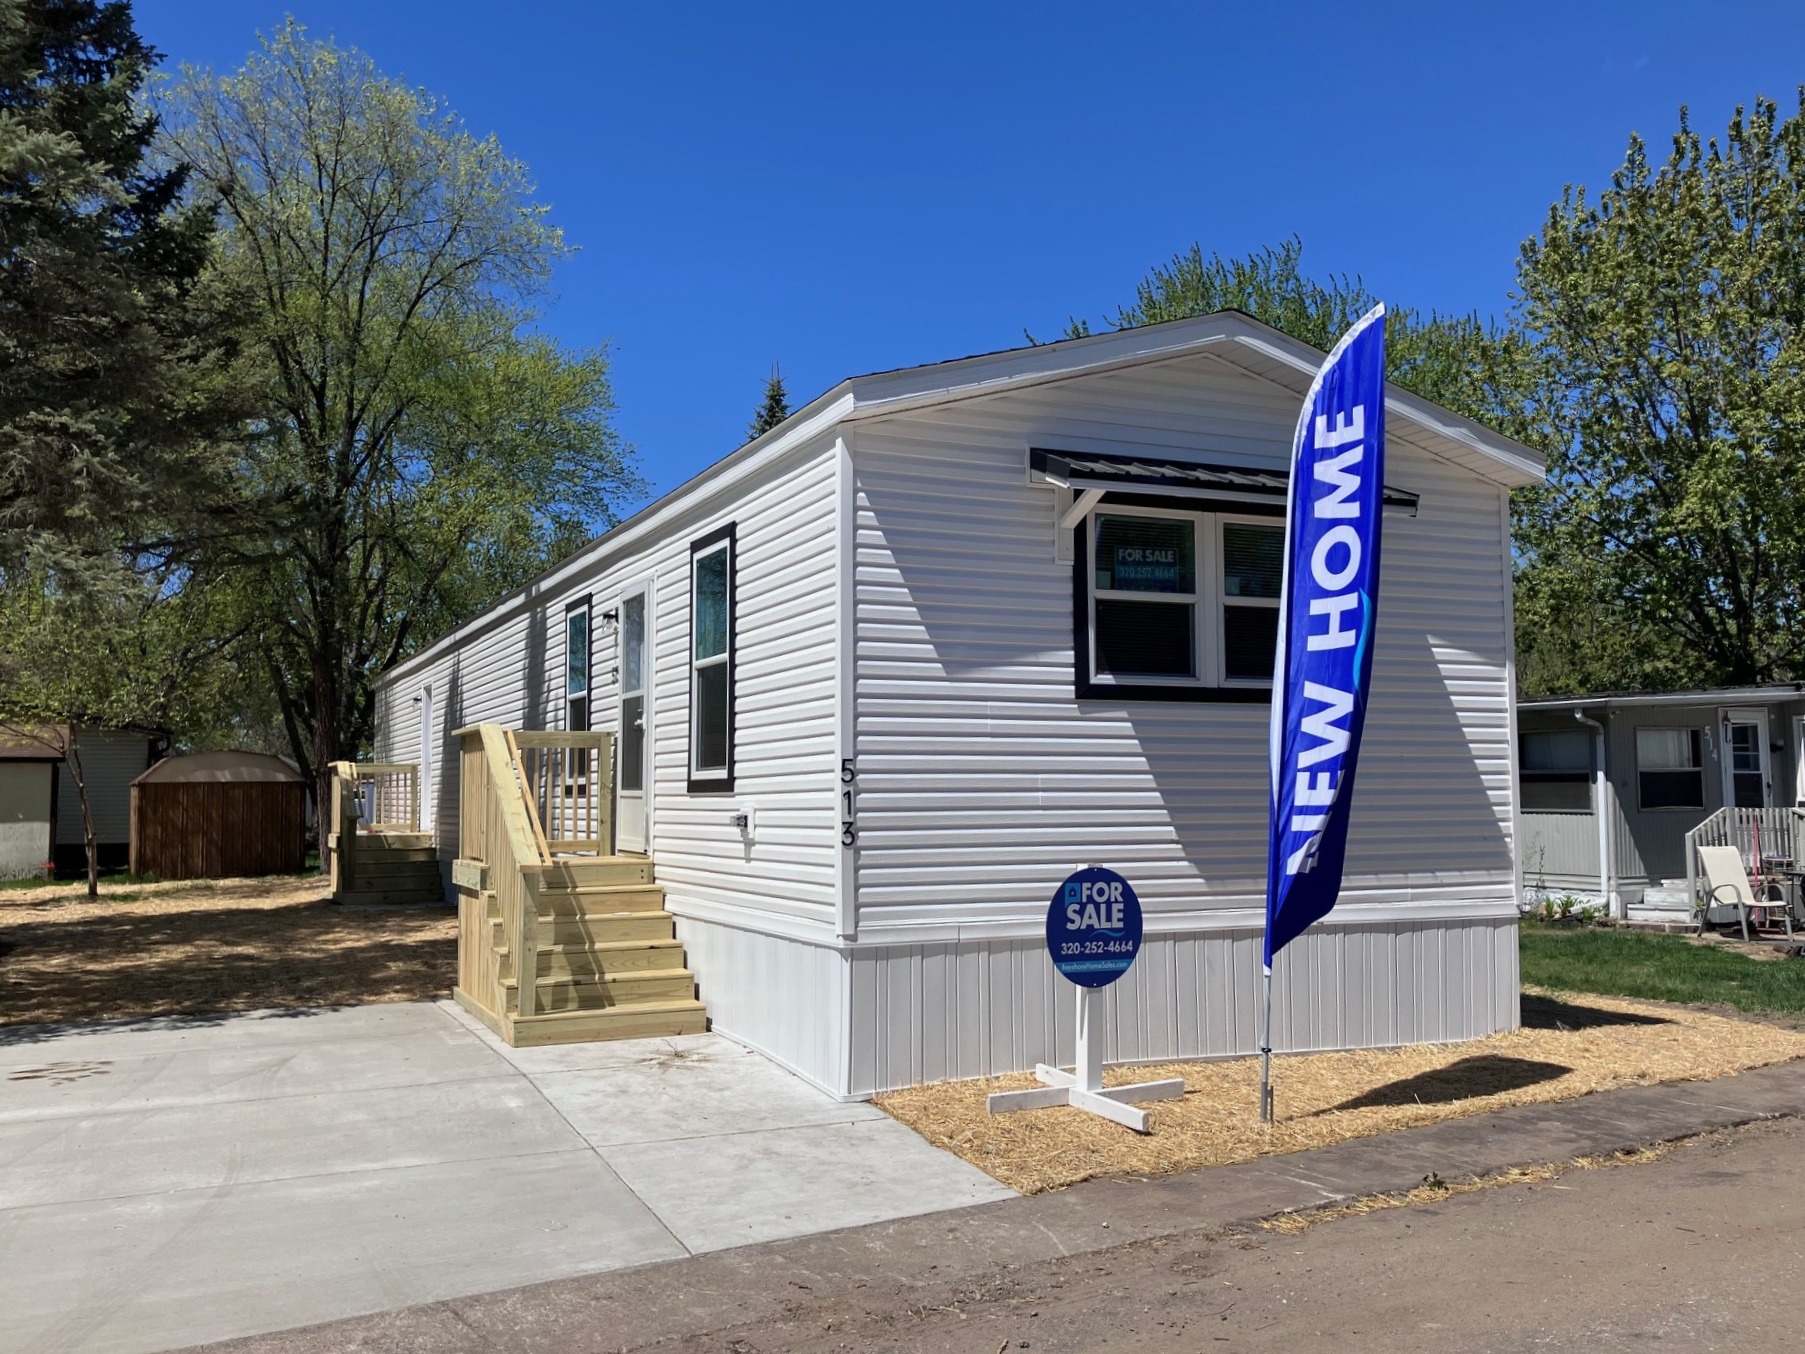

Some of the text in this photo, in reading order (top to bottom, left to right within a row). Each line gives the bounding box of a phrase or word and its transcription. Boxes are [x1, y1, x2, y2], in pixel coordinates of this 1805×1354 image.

[1306, 404, 1365, 651] HOME
[1118, 549, 1174, 563] FOR SALE
[841, 759, 855, 847] 513
[1081, 881, 1124, 903] FOR
[1066, 902, 1124, 930] SALE
[1061, 940, 1133, 955] 320-252-4664
